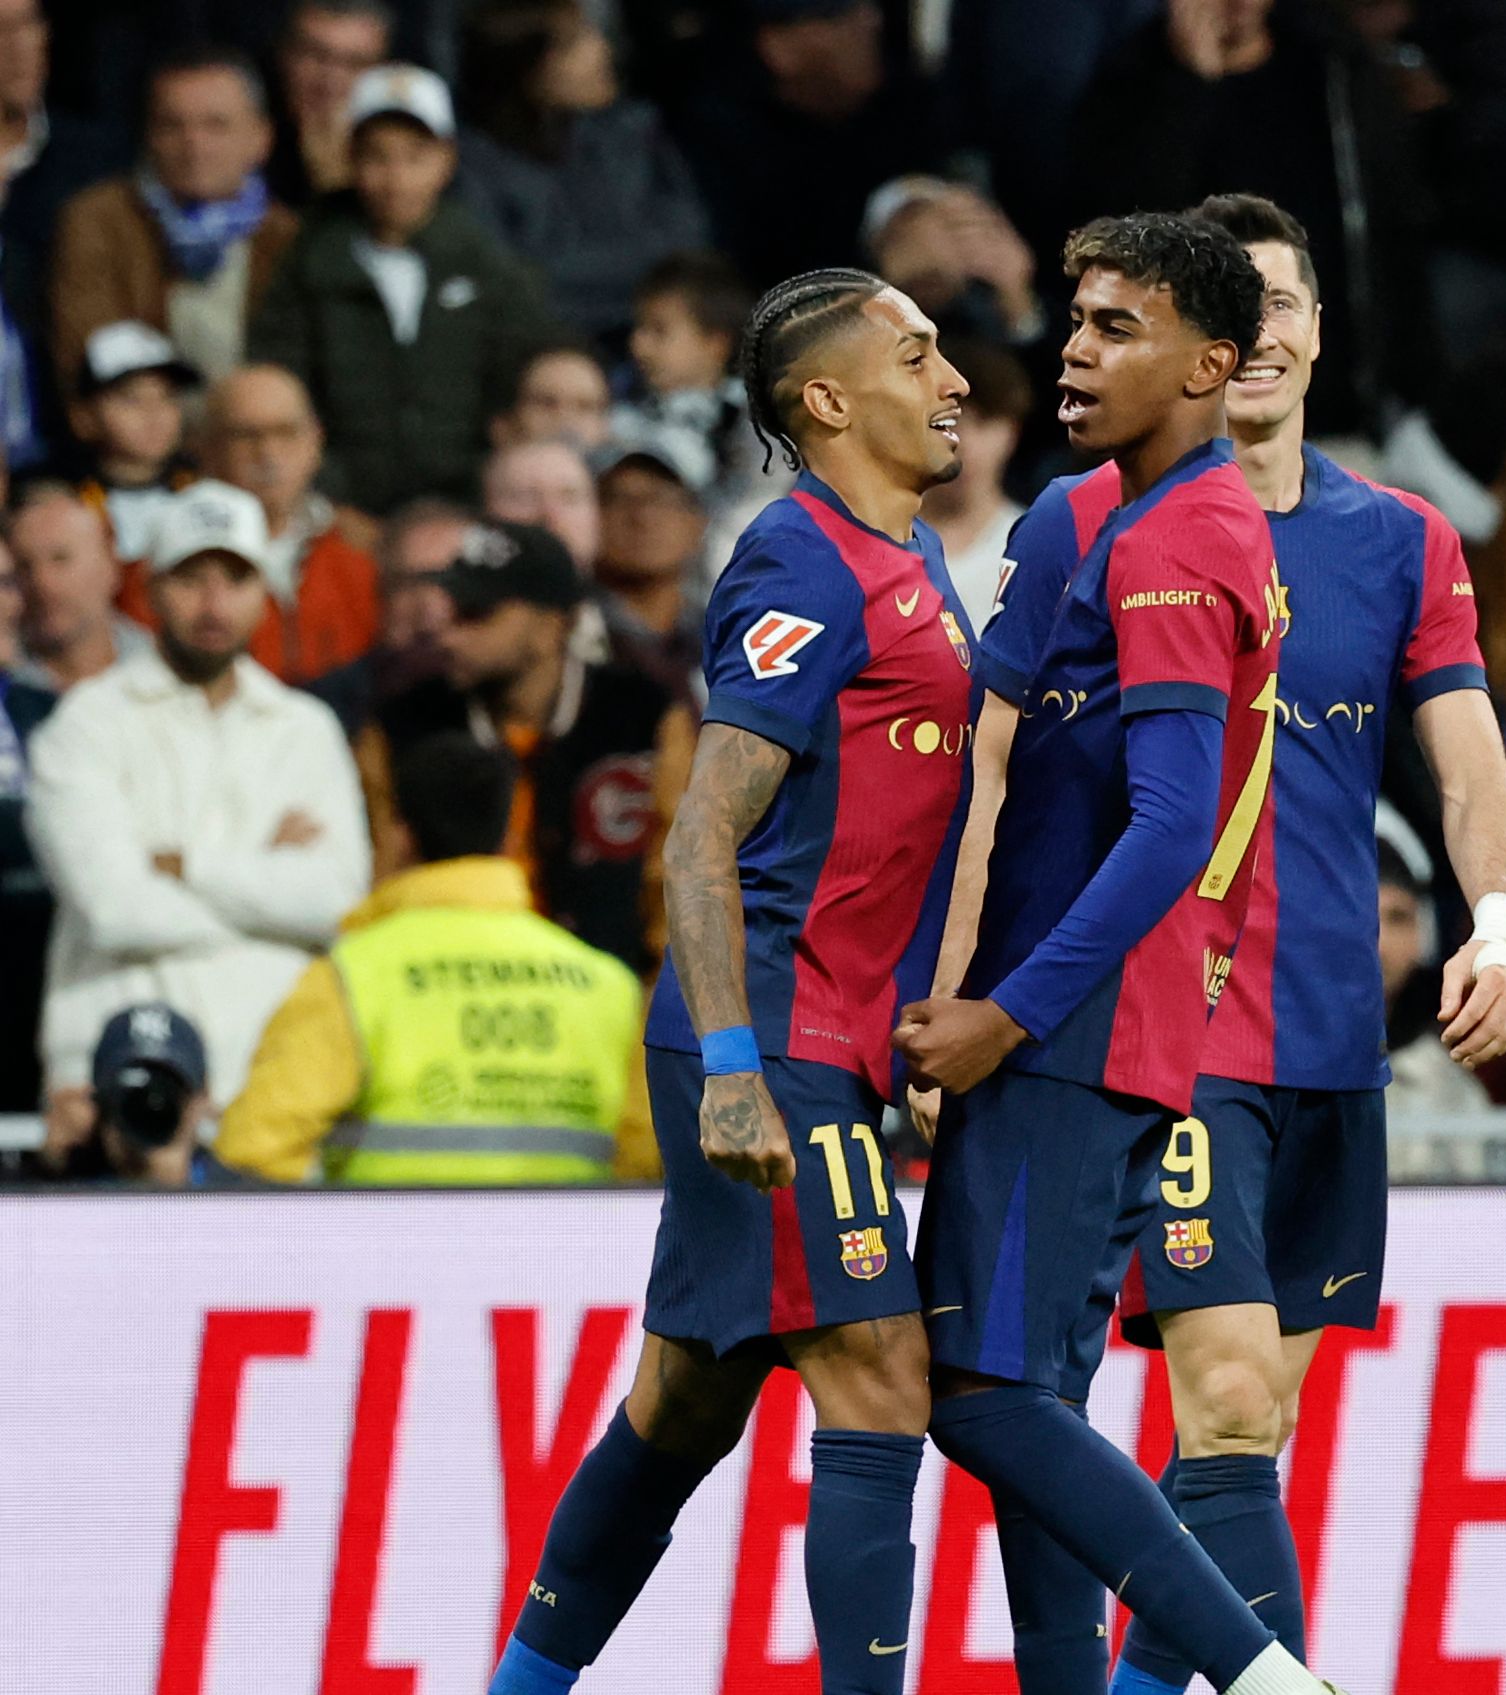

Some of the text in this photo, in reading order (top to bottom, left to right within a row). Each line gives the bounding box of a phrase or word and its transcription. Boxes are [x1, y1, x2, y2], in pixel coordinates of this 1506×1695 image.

[808, 1122, 890, 1220] 11
[1160, 1116, 1212, 1209] 9
[157, 1305, 635, 1695] FLY
